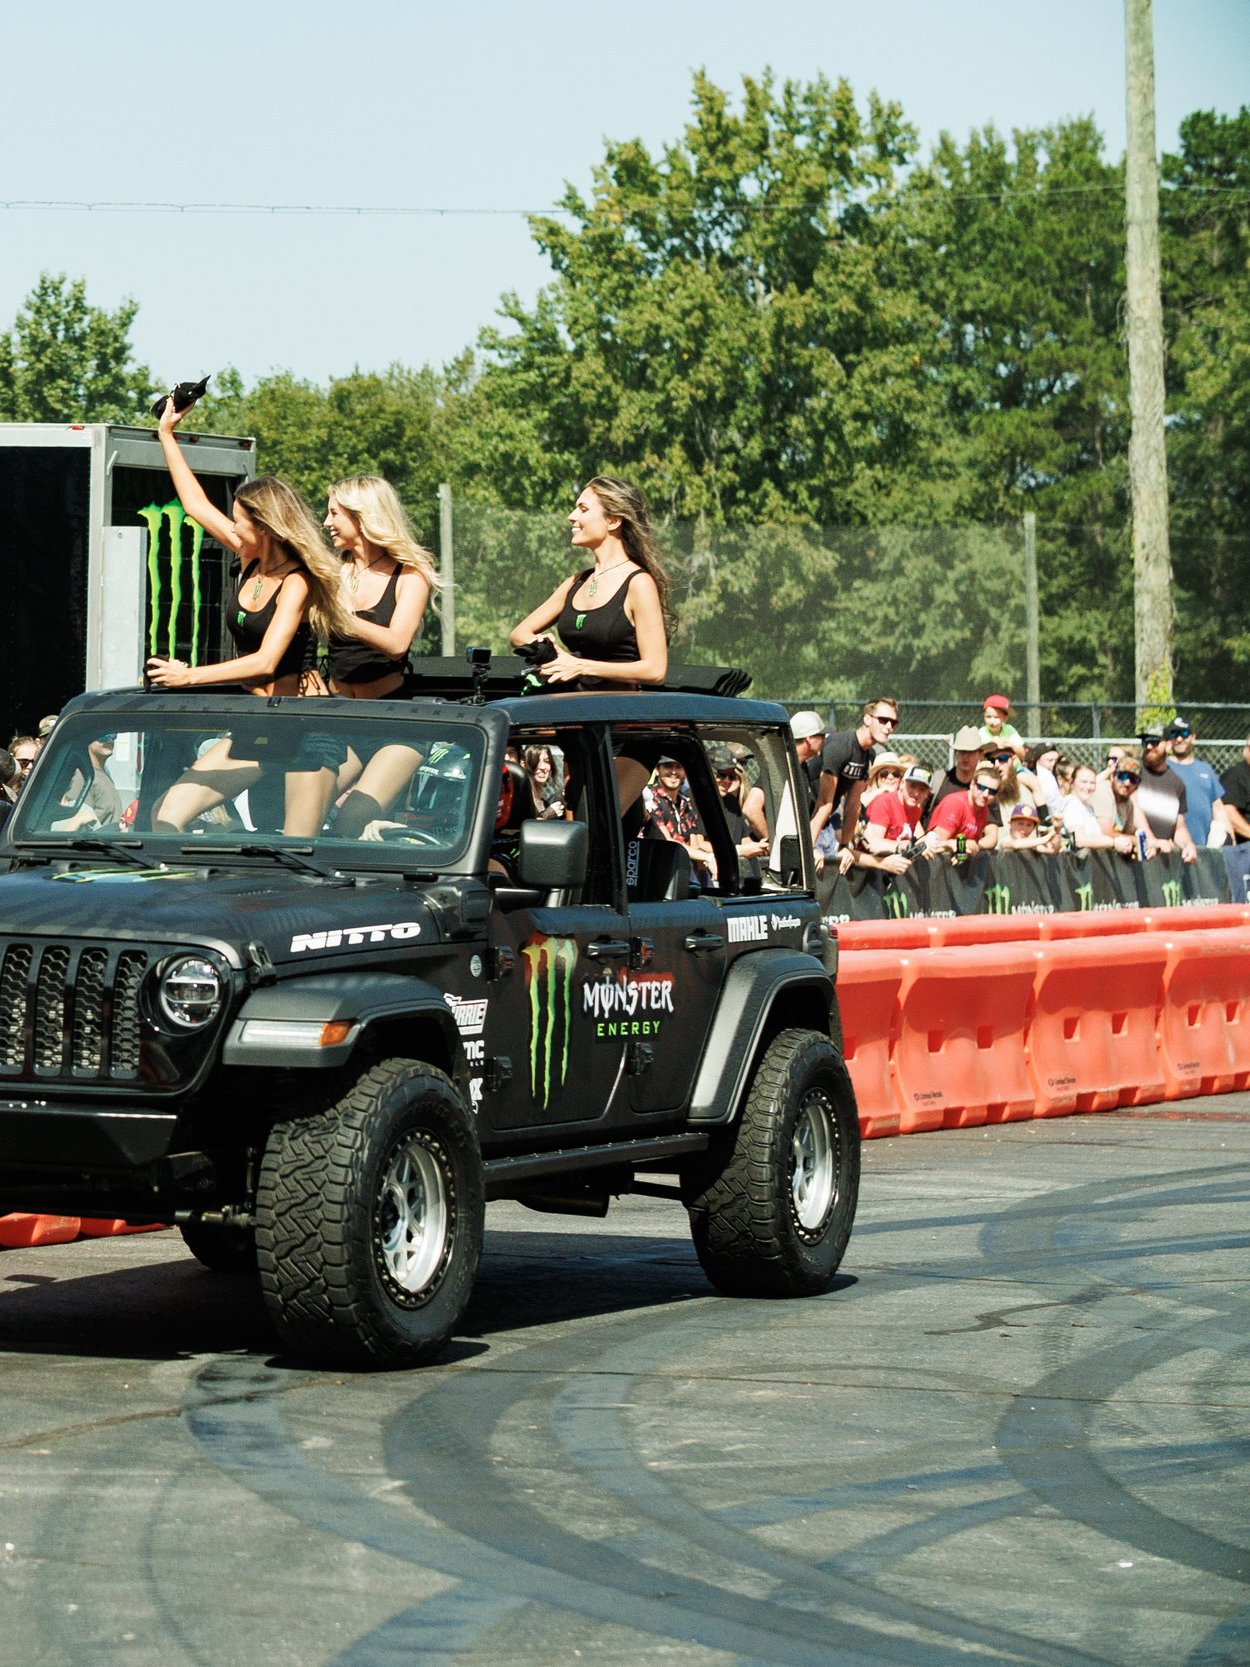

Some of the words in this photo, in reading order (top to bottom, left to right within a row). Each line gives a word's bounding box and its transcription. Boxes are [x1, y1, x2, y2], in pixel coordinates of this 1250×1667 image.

[290, 922, 422, 953] NITTO
[727, 915, 768, 942] MAHLE
[583, 975, 674, 1019] MONSTER
[597, 1021, 661, 1036] ENERGY
